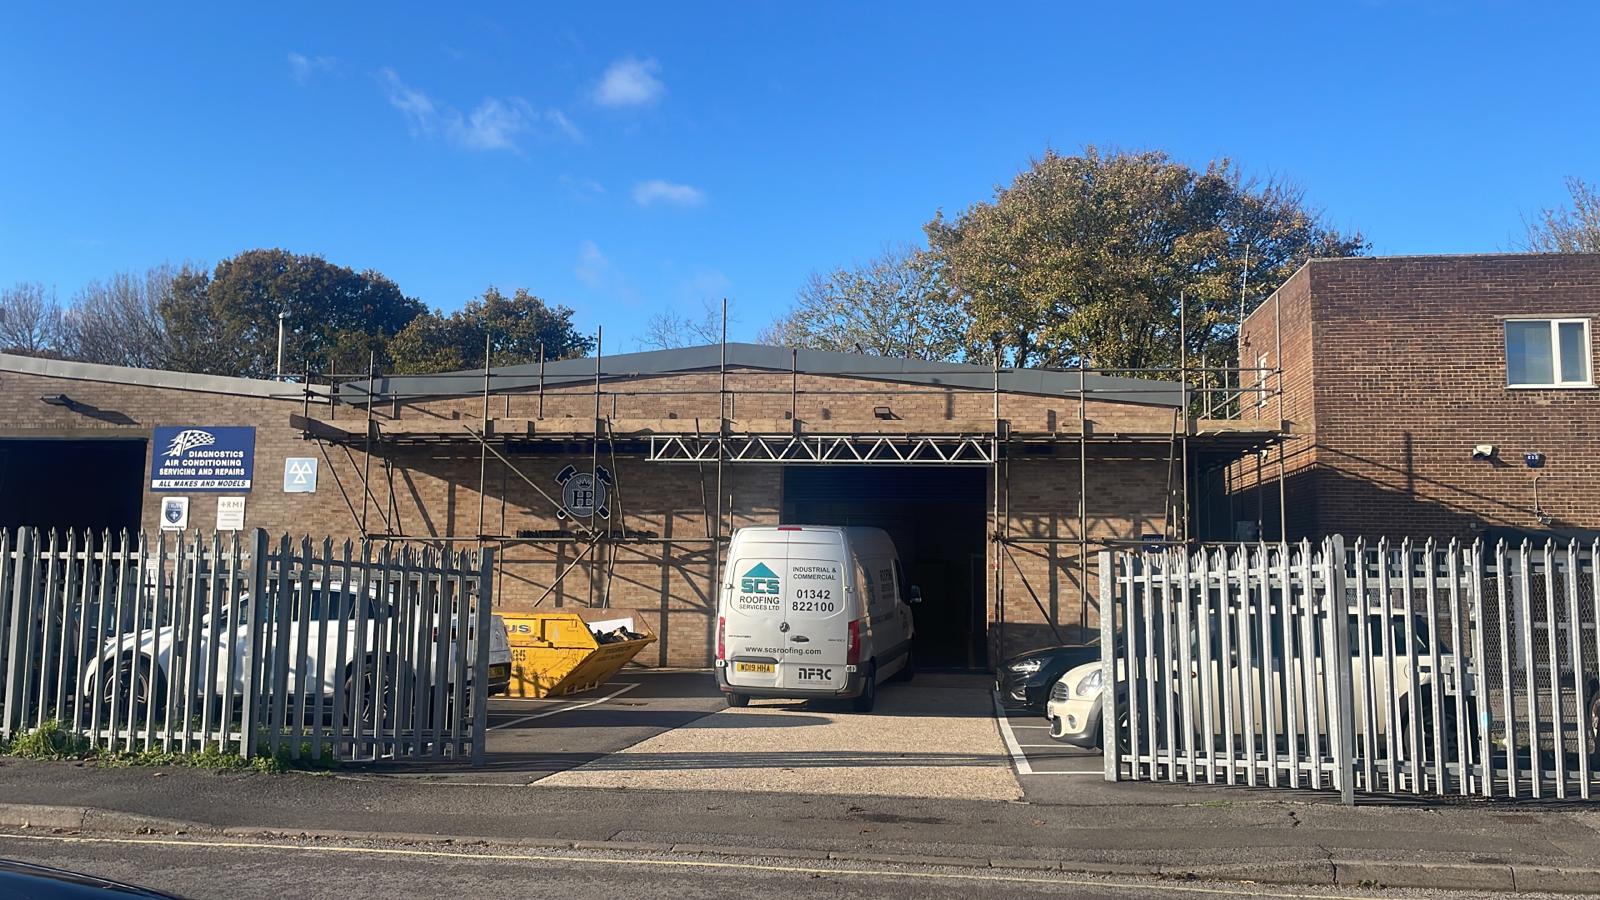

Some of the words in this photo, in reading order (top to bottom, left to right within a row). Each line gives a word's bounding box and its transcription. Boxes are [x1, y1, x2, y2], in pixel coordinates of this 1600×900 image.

[188, 450, 244, 458] DIAGNOSTICS
[164, 459, 179, 467] AIR
[182, 459, 242, 467] CONDITIONING
[159, 468, 196, 476] SERVICING
[197, 468, 213, 476] AND
[215, 468, 245, 476] REPAIRS
[158, 480, 172, 488] ALL
[173, 480, 198, 488] MAKES
[200, 480, 215, 488] AND
[217, 480, 246, 488] MODELS
[792, 566, 831, 574] INDUSTRIAL
[792, 573, 837, 581] COMMERCIAL
[741, 578, 780, 595] SCS
[796, 589, 831, 600] 01342
[739, 595, 780, 605] ROOFING
[791, 601, 834, 613] 822100
[744, 646, 822, 656] www.scsroofing.com
